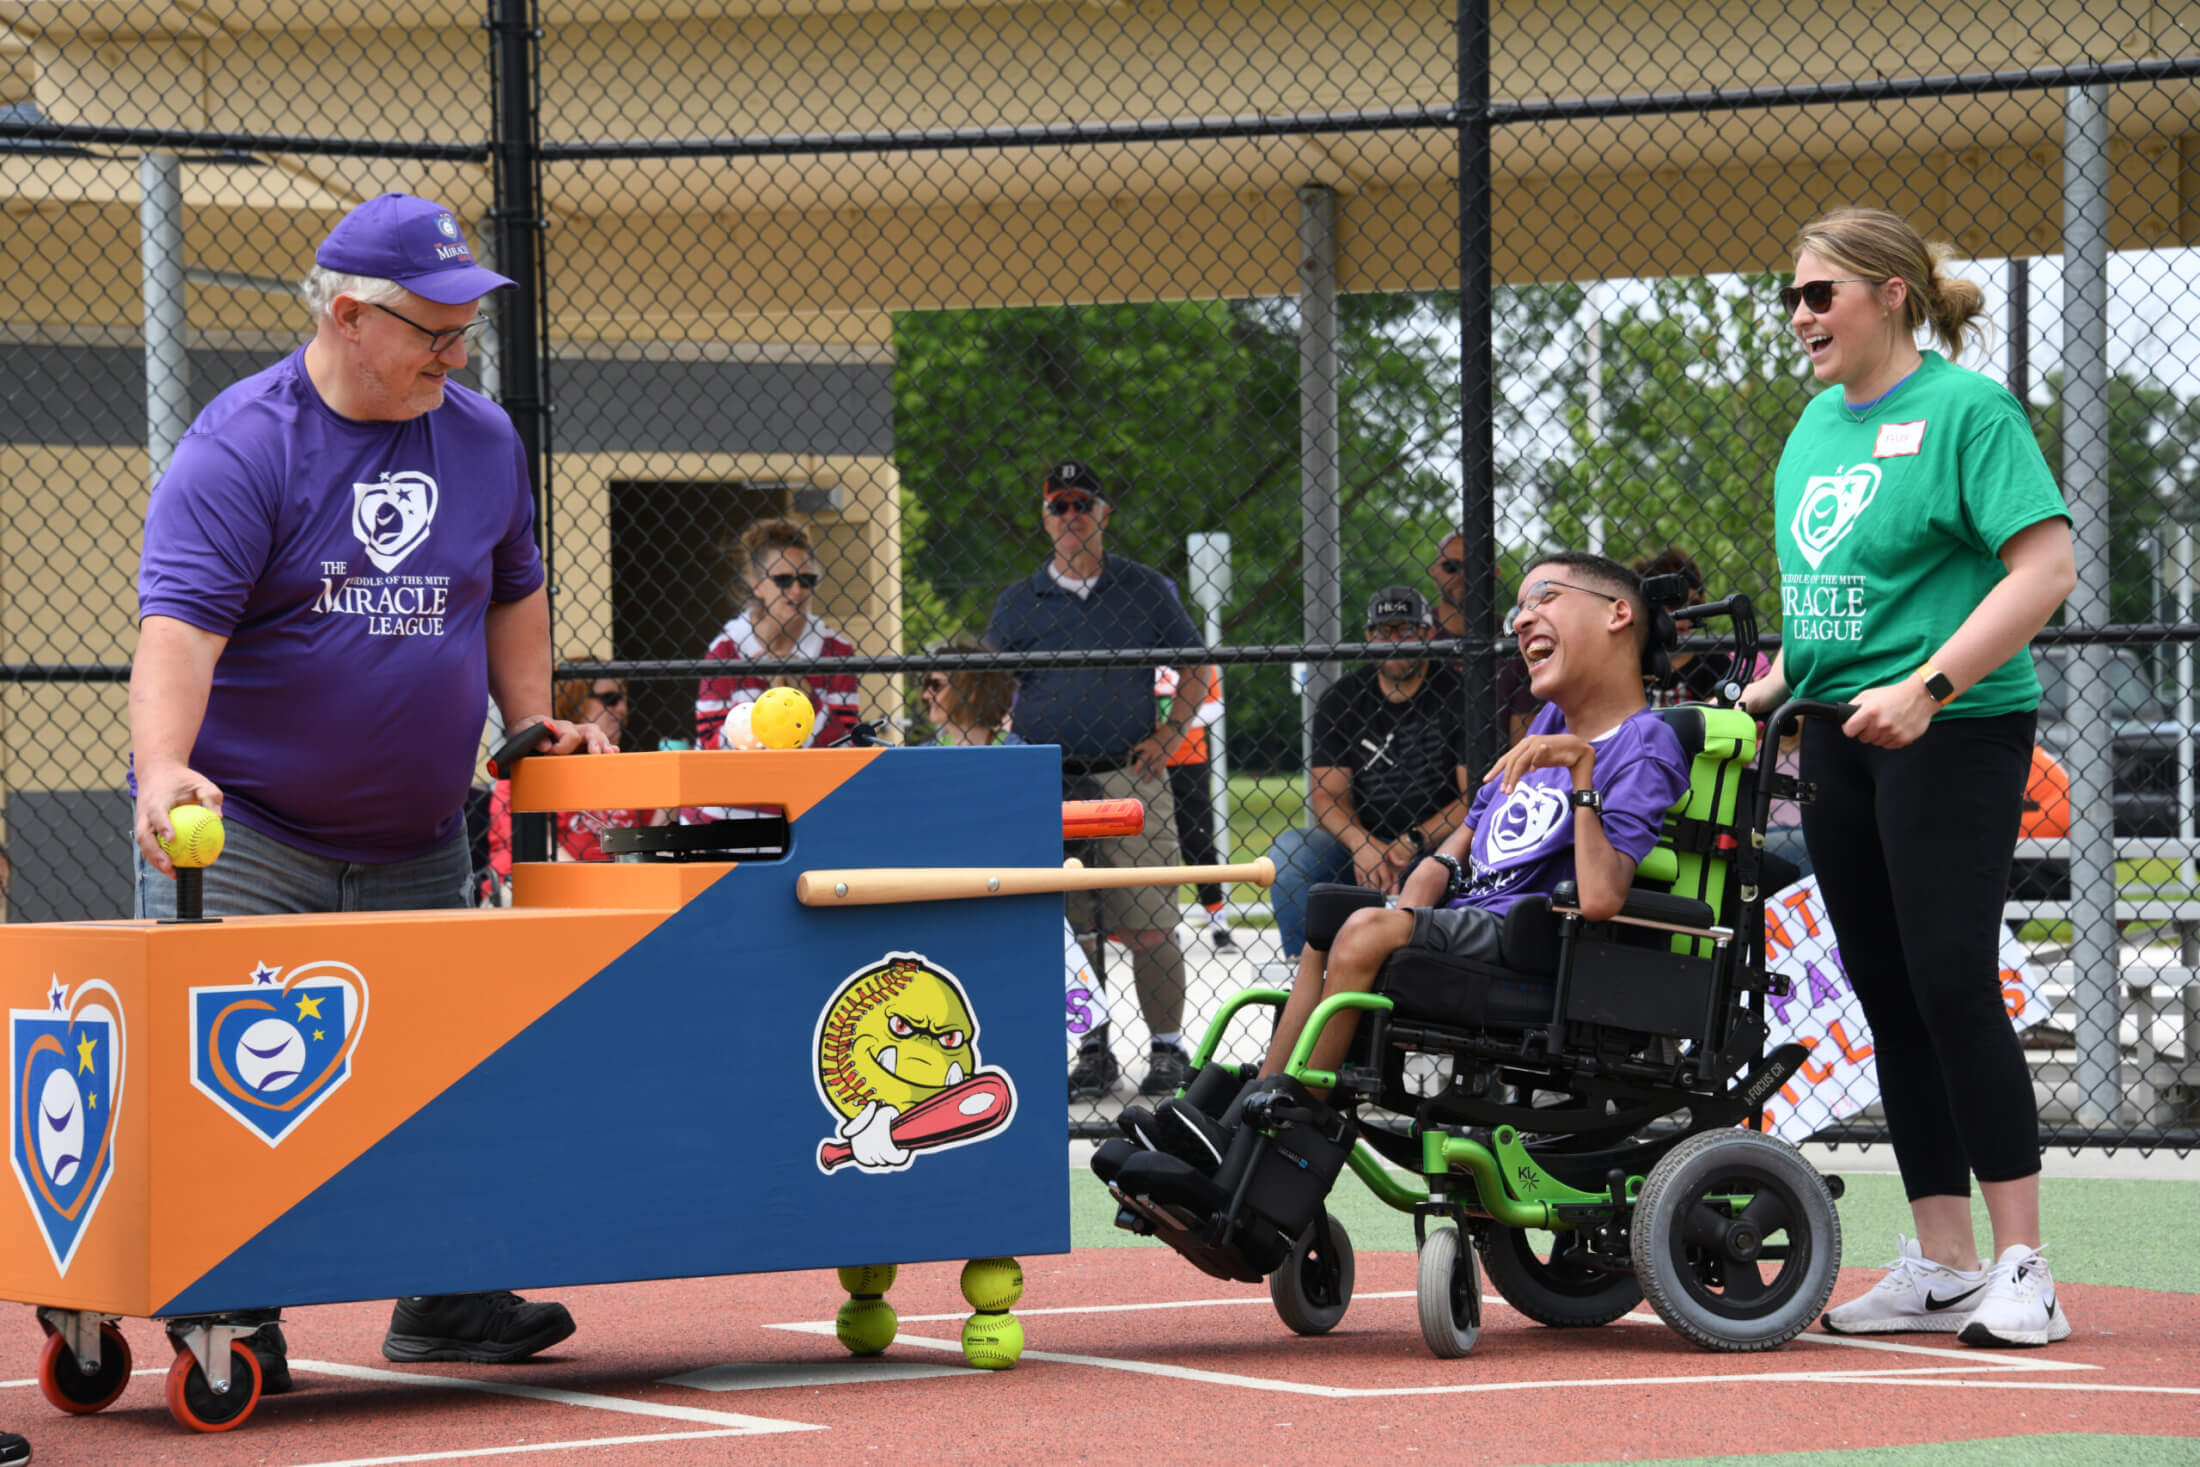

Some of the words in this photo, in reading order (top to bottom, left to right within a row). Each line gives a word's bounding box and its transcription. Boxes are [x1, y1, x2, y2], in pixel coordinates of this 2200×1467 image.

[320, 561, 347, 575] THE
[385, 576, 400, 585] OF
[401, 576, 423, 585] THE
[425, 576, 450, 585] MITT
[1821, 575, 1838, 585] THE
[1840, 575, 1867, 585] MITT
[311, 577, 448, 615] MIRACLE
[1782, 586, 1867, 617] IRACLE
[368, 617, 444, 636] LEAGUE
[1793, 619, 1863, 641] LEAGUE
[1748, 1072, 1775, 1100] FOCUS
